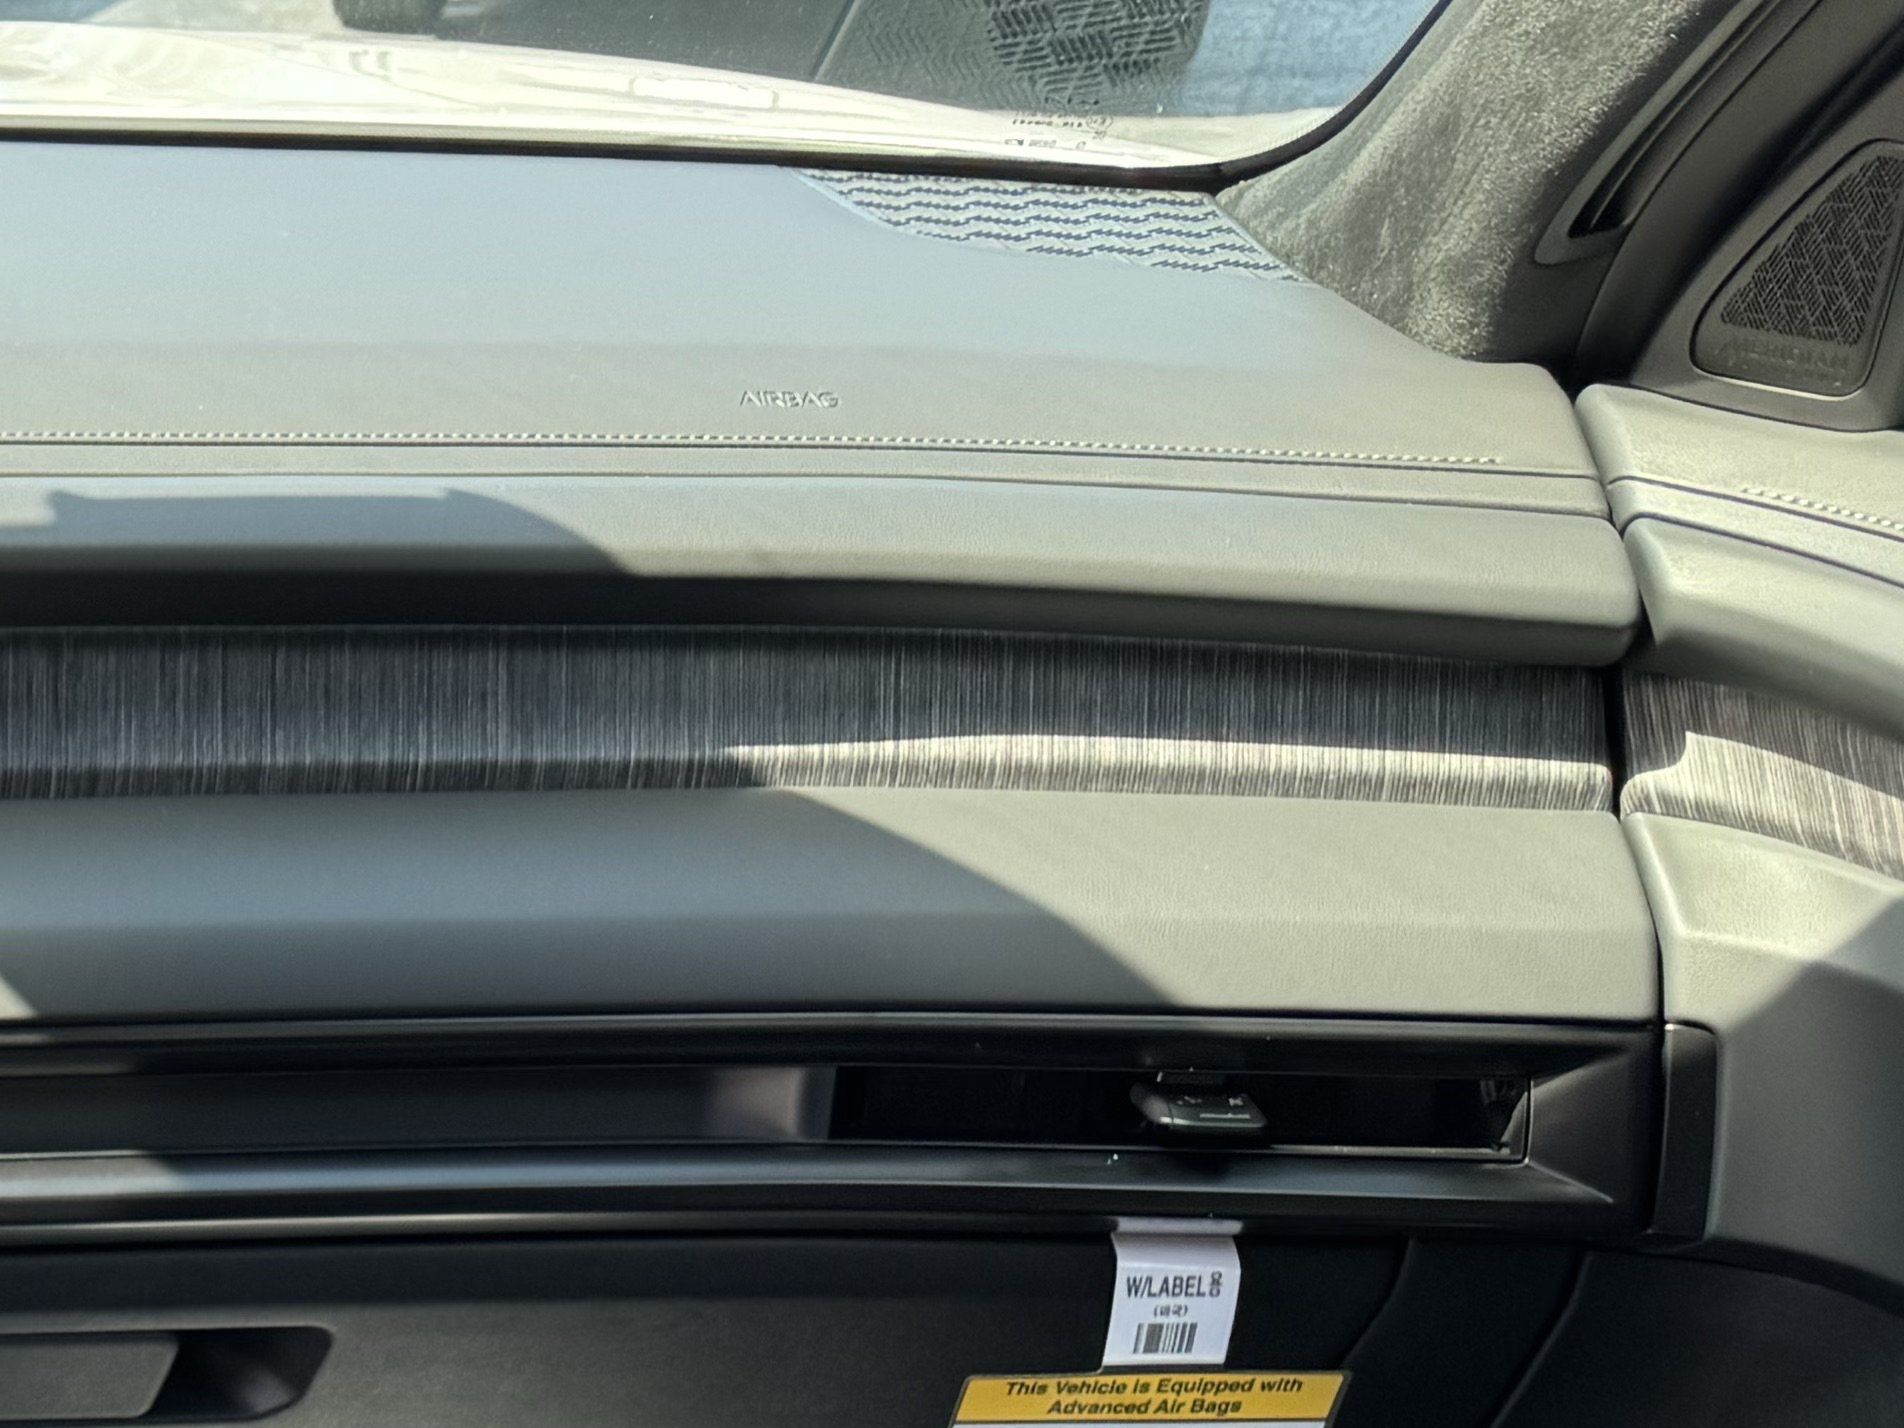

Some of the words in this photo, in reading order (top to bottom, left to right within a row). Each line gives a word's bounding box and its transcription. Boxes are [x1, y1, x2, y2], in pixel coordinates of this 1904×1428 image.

[740, 390, 840, 408] AIRBAG
[1006, 1381, 1048, 1396] This
[1056, 1380, 1128, 1395] Vehicle
[1133, 1379, 1149, 1394] is
[1156, 1378, 1255, 1397] Equipped
[1260, 1377, 1304, 1393] with
[1047, 1400, 1152, 1415] Advanced
[1153, 1399, 1186, 1415] Air
[1190, 1398, 1243, 1416] Bags
